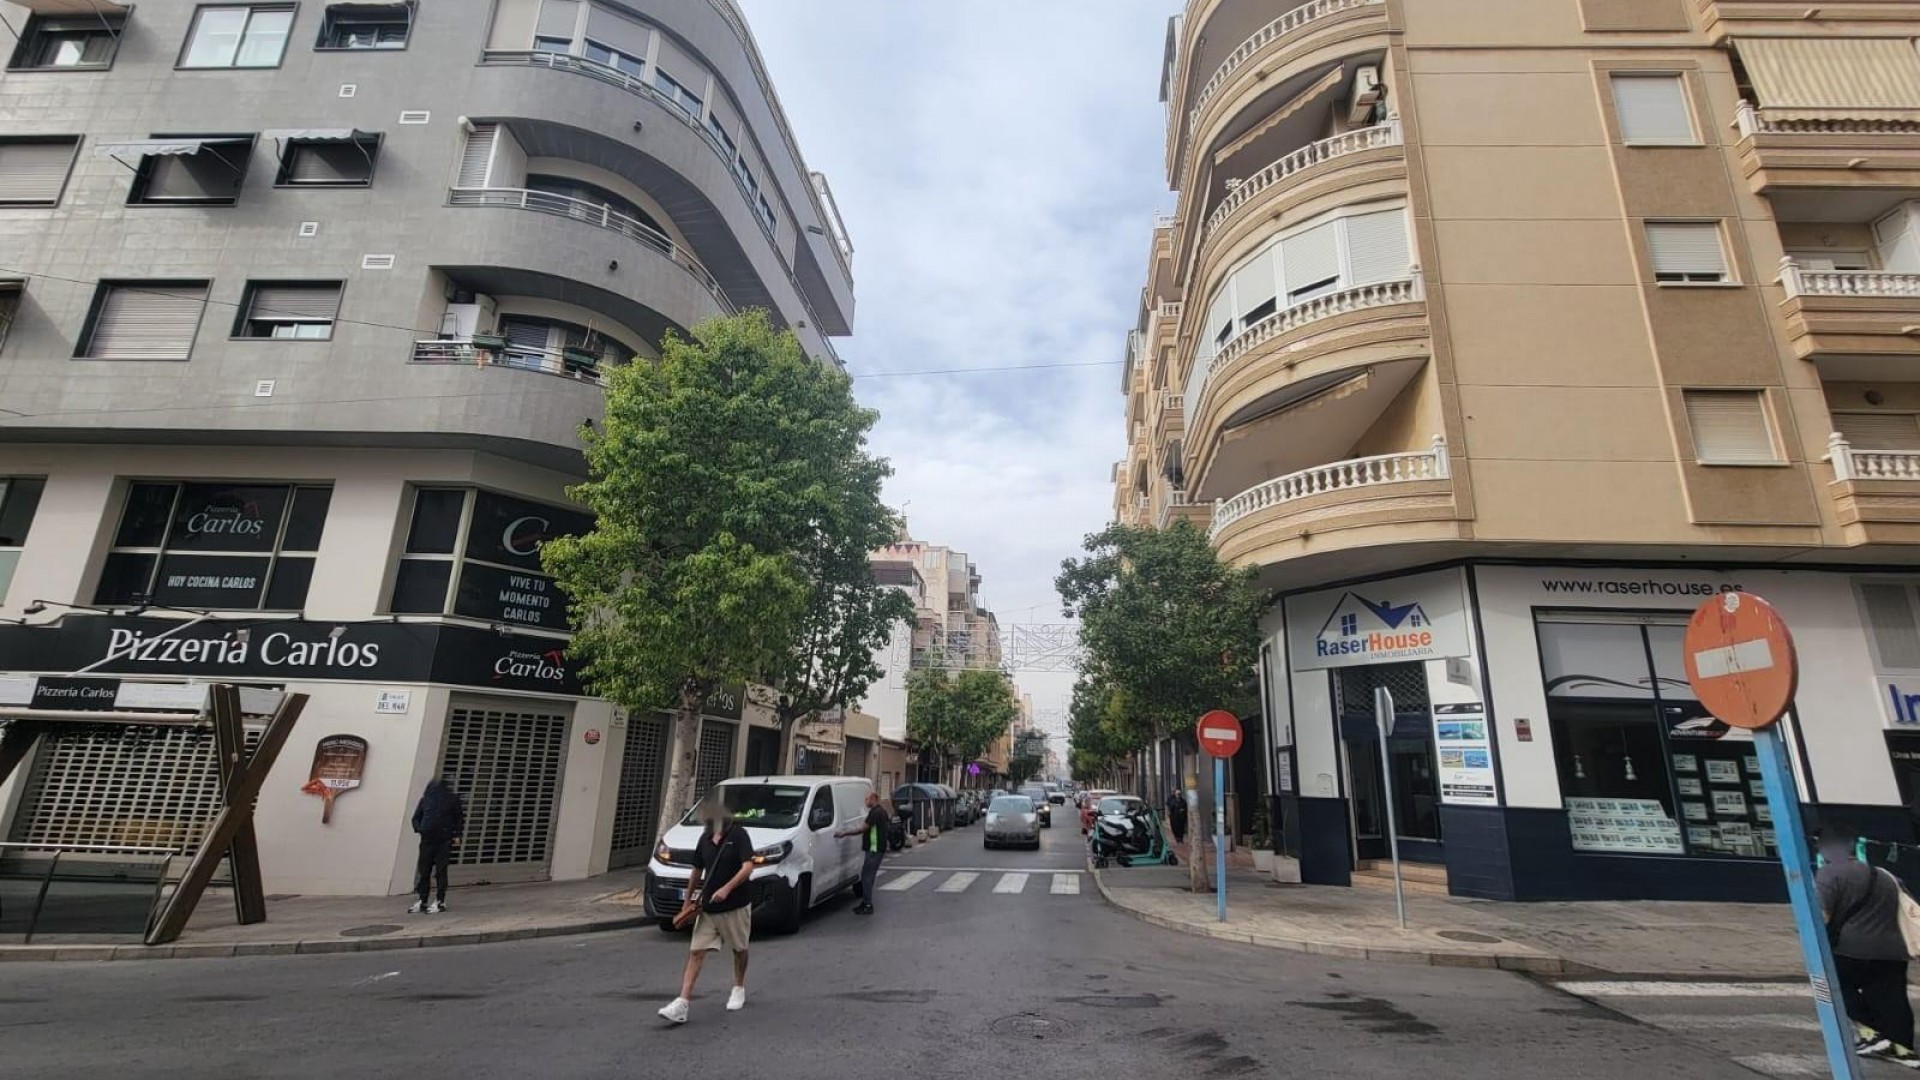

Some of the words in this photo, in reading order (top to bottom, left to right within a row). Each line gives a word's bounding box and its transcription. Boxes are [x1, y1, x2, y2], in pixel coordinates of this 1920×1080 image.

[187, 512, 264, 535] Carlos
[167, 575, 187, 588] HOY
[187, 576, 220, 588] COCINA
[221, 577, 257, 589] CARLOS
[510, 575, 531, 590] VIVE
[533, 579, 546, 592] TU
[1541, 579, 1745, 595] www.raserhouse.es
[499, 590, 550, 608] MOMENTO
[503, 607, 541, 623] CARLOS
[106, 628, 248, 664] Pizzería
[260, 632, 379, 667] Carlos
[1316, 631, 1432, 657] RaserHouse
[1371, 647, 1434, 660] INMOBILIARIA
[494, 656, 565, 680] Carlos
[80, 687, 115, 698] Carlos
